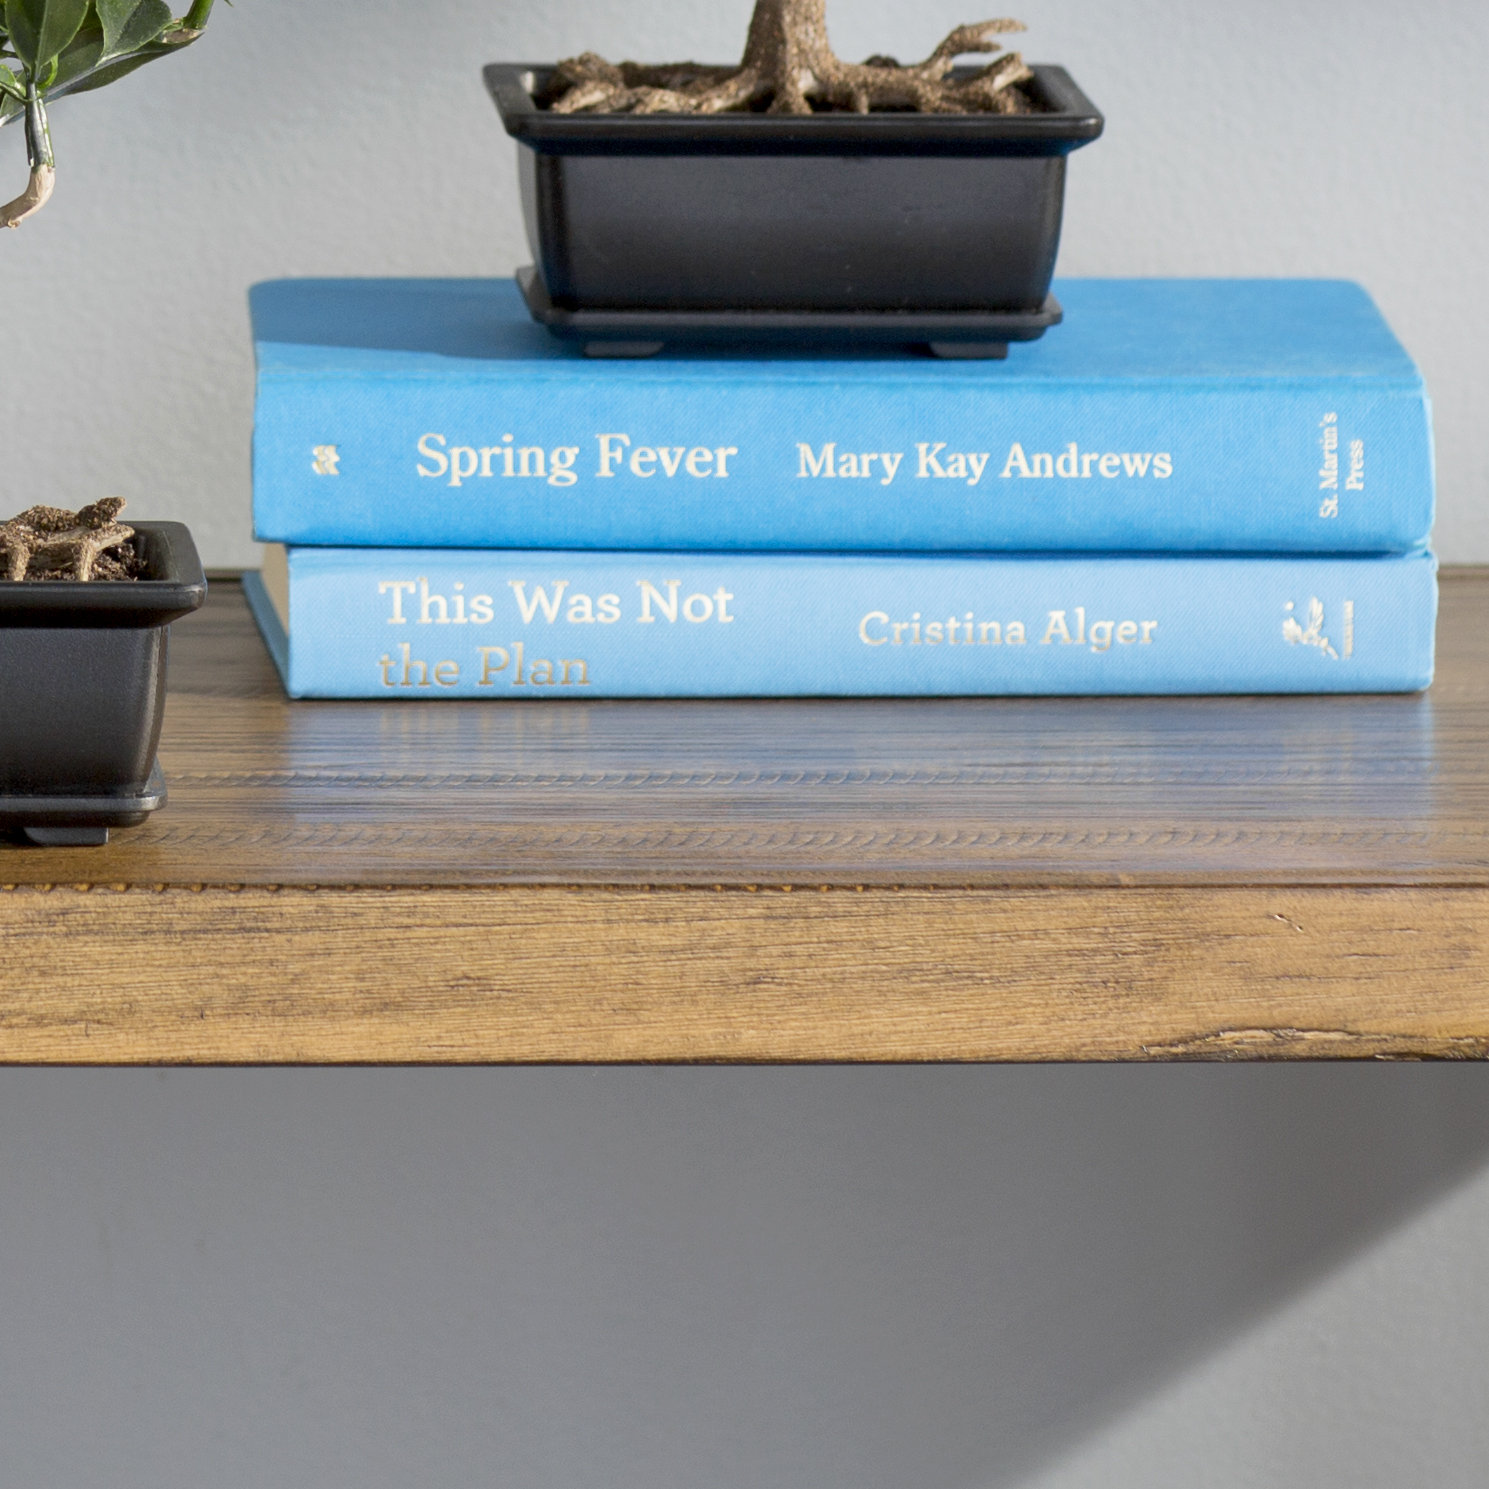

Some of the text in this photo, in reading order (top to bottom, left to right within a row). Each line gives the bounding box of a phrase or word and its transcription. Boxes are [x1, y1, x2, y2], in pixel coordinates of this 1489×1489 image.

[416, 433, 738, 487] Spring Fever
[796, 442, 1173, 485] Mary Kay Andrews
[1318, 411, 1338, 518] St. Martin's
[1344, 439, 1364, 491] Press
[378, 577, 734, 625] This Was Not
[858, 607, 1157, 653] Cristina Alger
[379, 642, 591, 687] the Plan
